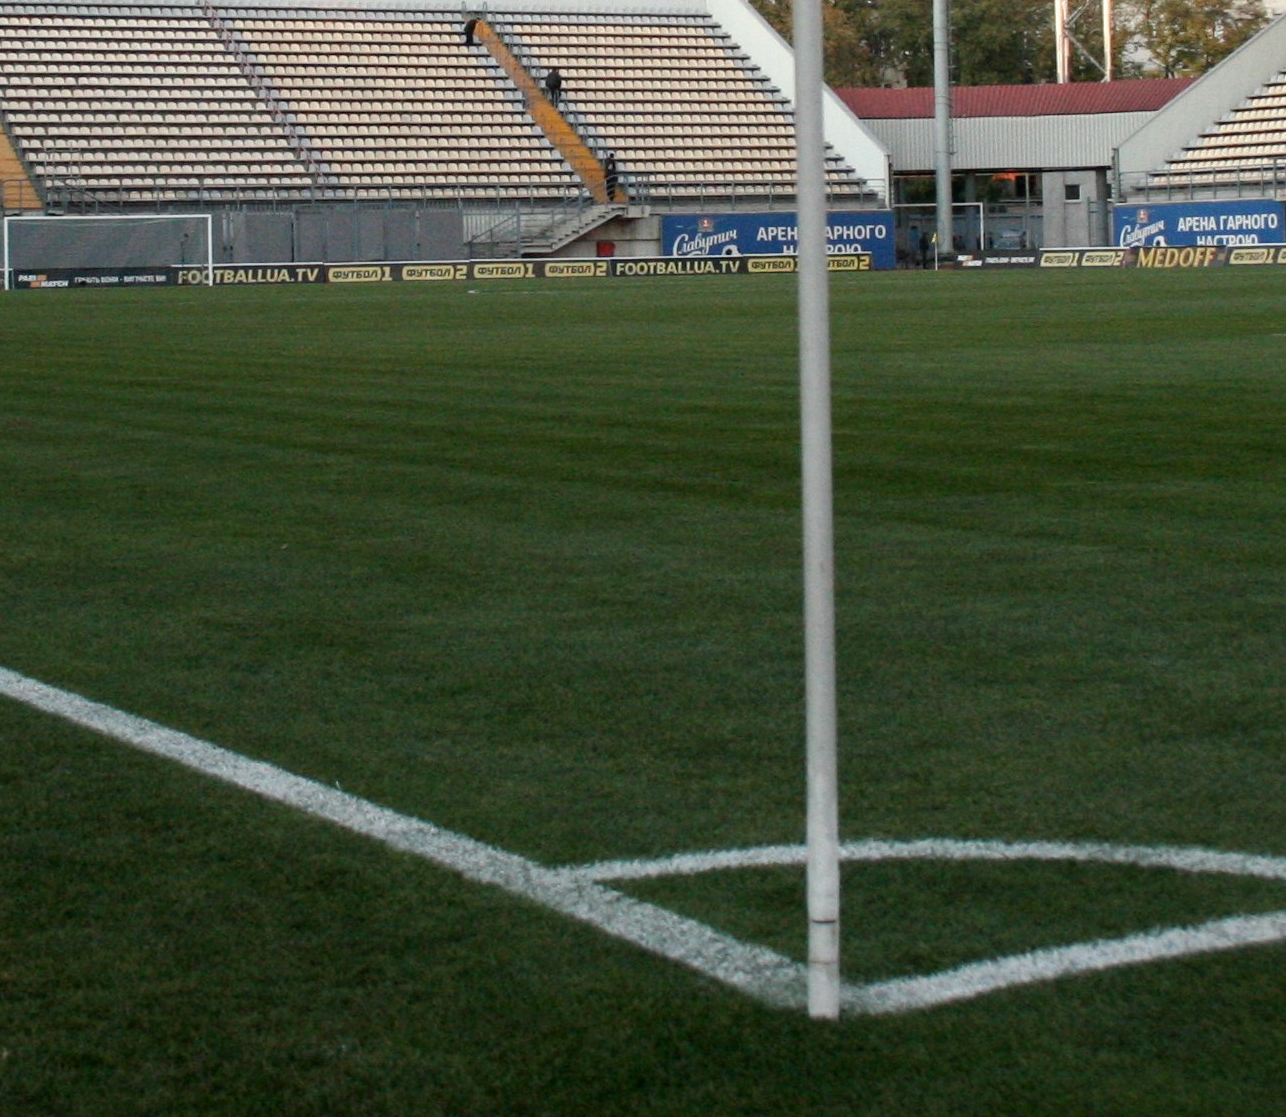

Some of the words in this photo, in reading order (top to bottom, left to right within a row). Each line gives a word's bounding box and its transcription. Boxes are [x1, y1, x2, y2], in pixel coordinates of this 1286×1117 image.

[1177, 216, 1217, 232] АРЕНА
[1220, 213, 1278, 229] ГАРНОГО
[757, 226, 798, 241] АРЕН
[825, 224, 886, 240] АРНОГО
[1136, 247, 1217, 268] MEDOFF
[332, 269, 378, 278] ФУТБОЛ
[406, 267, 451, 276] ФУТБОЛ
[478, 265, 521, 275] ФУТБОЛ
[548, 264, 591, 273] ФУТБОЛ
[616, 260, 740, 275] FOOTBALLUA.TV
